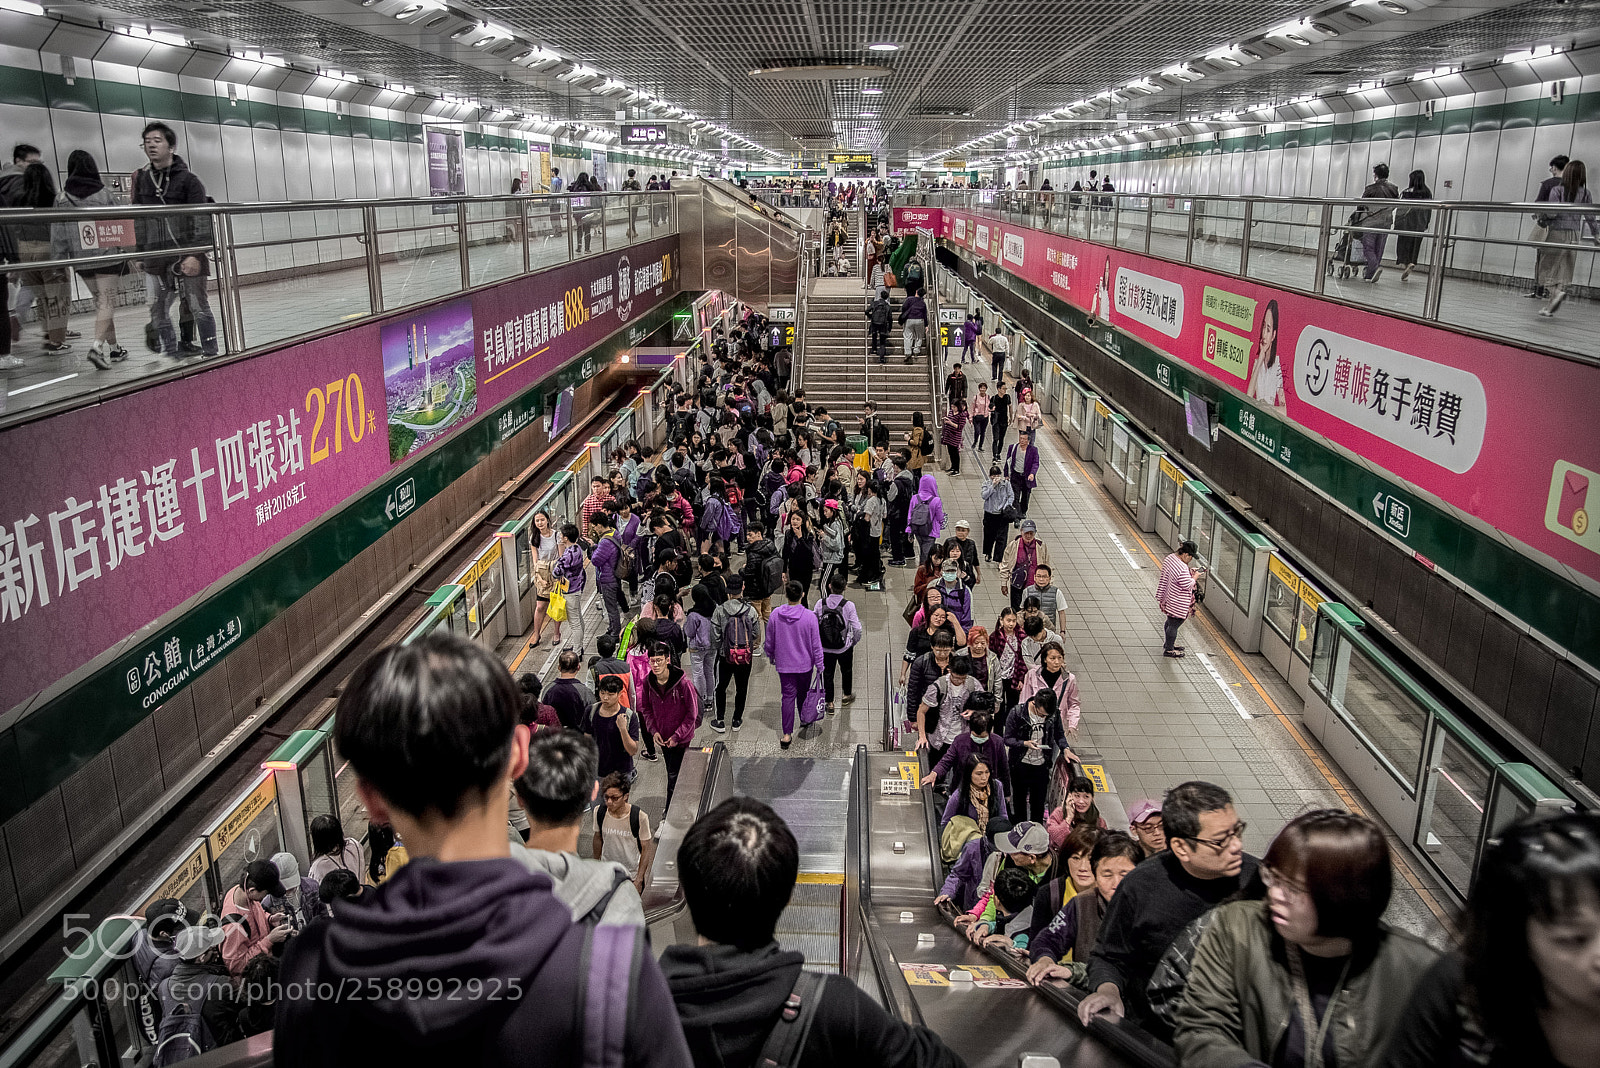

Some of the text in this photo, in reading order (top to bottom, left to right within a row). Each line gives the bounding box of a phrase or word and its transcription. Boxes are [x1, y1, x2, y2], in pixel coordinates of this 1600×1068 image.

[1230, 344, 1244, 364] $520
[1333, 354, 1462, 446] 轉帳免手續費
[1243, 411, 1256, 431] 公館
[255, 482, 307, 526] 預計2018完工
[1390, 502, 1405, 521] 新店
[1389, 516, 1403, 531] Xindian
[143, 636, 182, 687] 公館
[142, 667, 190, 708] GONGGUAN
